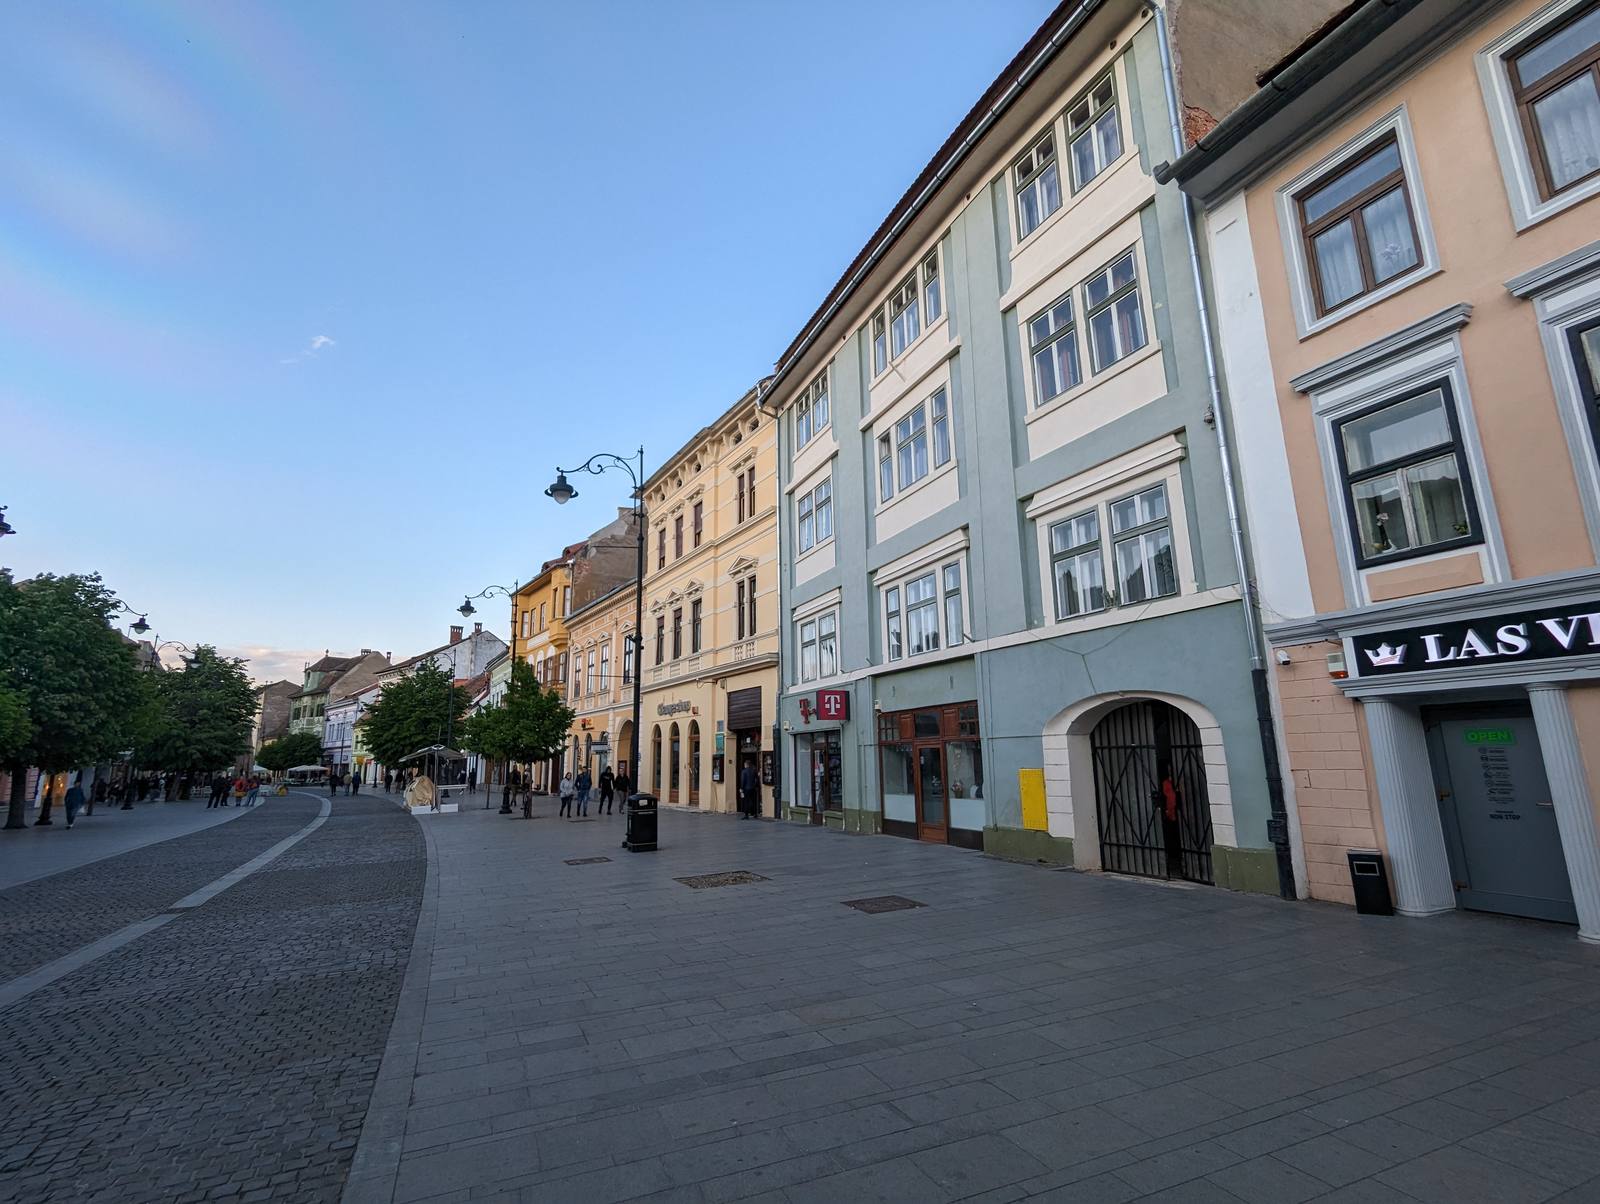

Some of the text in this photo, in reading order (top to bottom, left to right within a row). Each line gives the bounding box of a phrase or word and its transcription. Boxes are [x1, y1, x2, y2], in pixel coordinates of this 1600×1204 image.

[1420, 622, 1530, 662] LAS
[824, 694, 841, 715] T
[1467, 731, 1508, 742] OPEN
